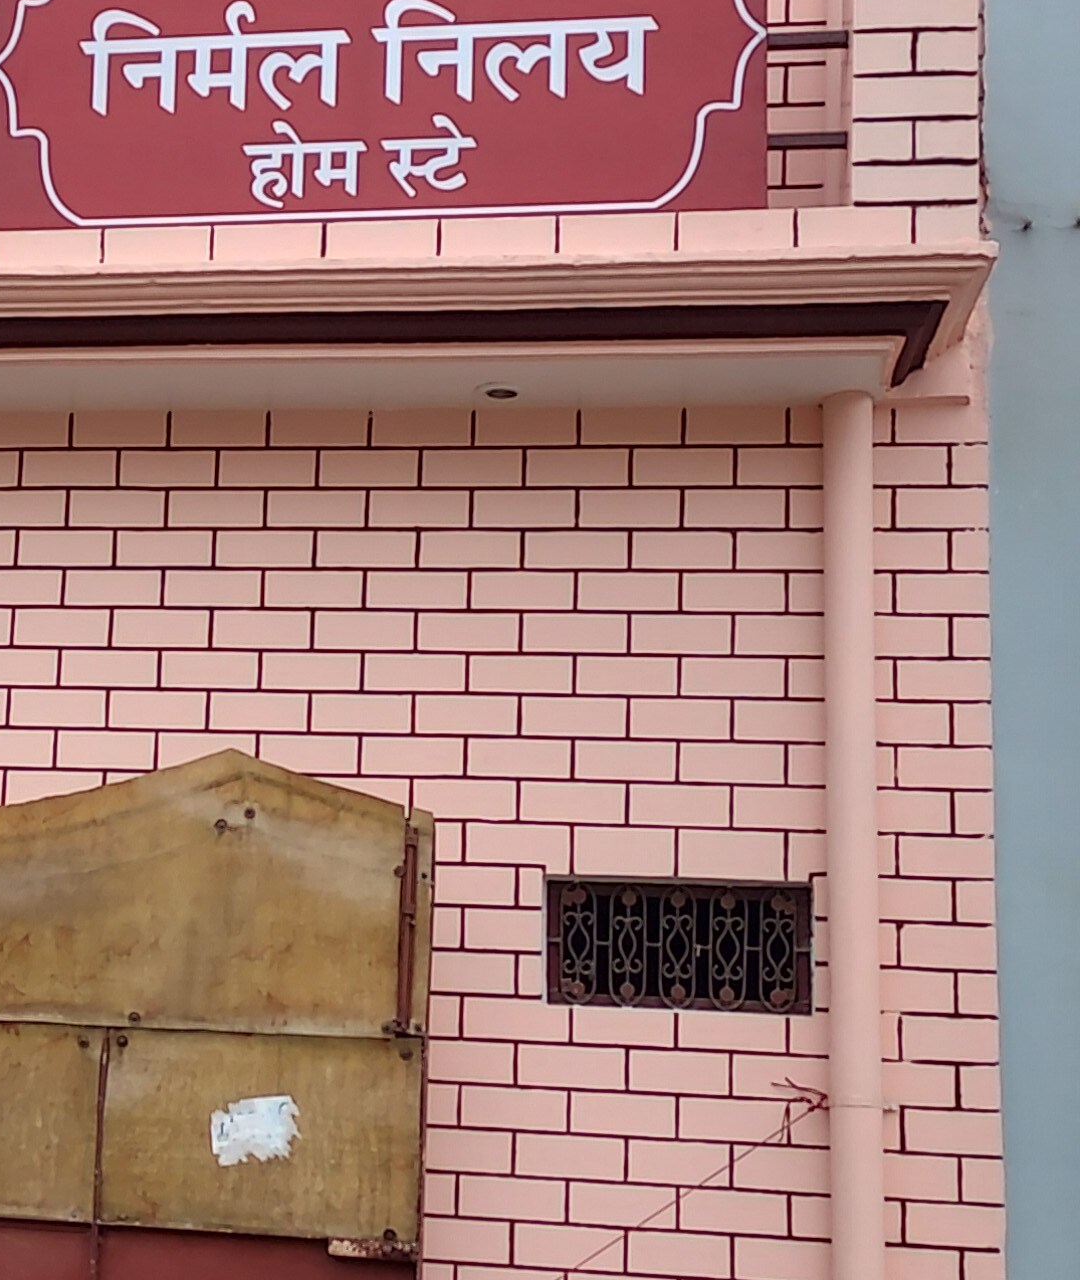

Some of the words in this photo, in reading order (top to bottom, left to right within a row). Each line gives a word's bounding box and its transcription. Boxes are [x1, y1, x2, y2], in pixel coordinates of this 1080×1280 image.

[80, 0, 351, 116] निर्मल
[242, 120, 368, 209] होम
[380, 114, 477, 198] स्टे
